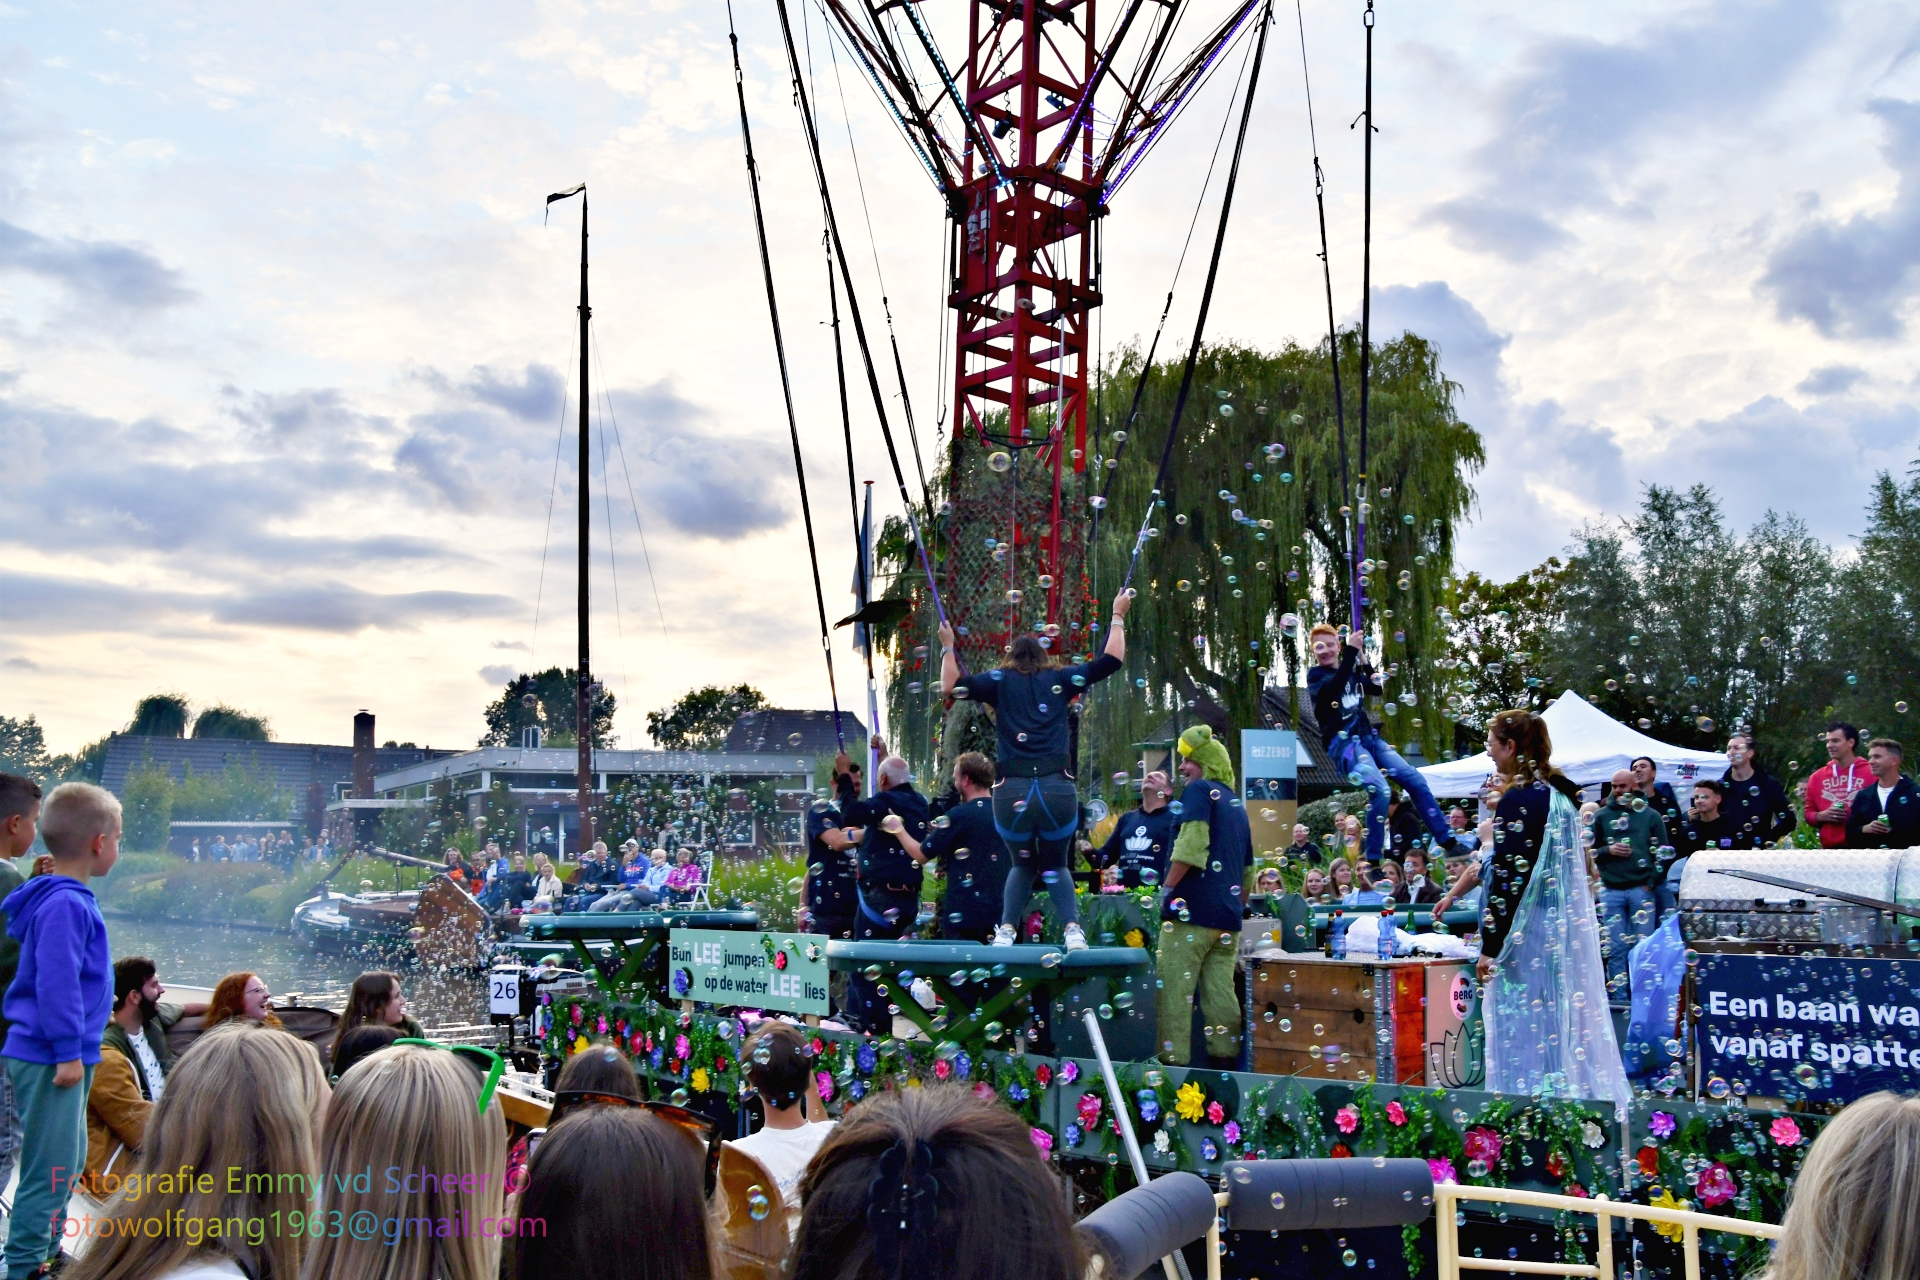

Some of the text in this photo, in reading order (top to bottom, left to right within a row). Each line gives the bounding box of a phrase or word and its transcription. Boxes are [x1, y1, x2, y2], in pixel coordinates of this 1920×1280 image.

[672, 942, 765, 970] Bun LEE jumpen
[493, 981, 517, 999] 26
[705, 973, 826, 1001] op de water LEE lies
[1709, 991, 1768, 1018] Een
[1776, 994, 1860, 1024] baan
[1710, 1033, 1803, 1060] vanaf
